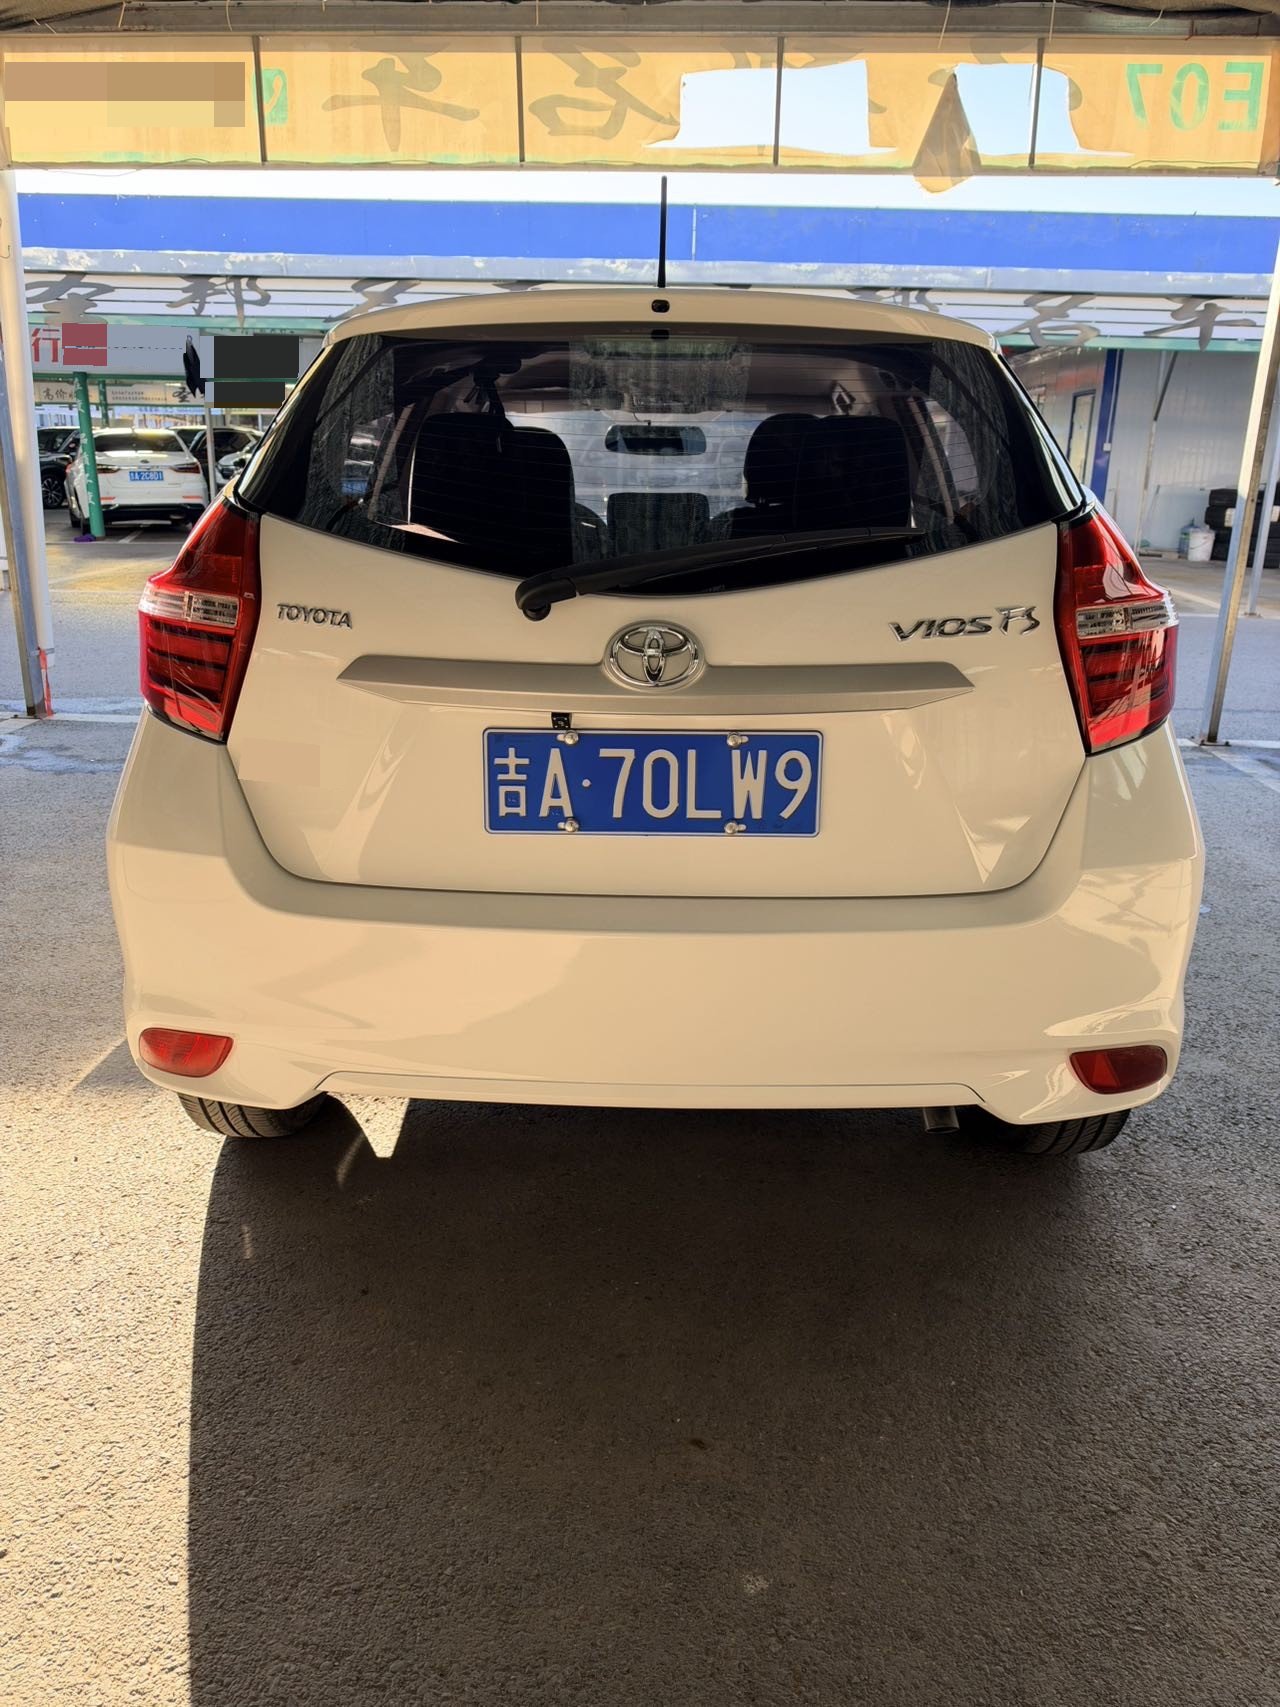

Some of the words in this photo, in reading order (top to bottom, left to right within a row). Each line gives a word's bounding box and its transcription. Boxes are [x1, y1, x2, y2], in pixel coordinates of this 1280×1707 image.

[277, 603, 353, 629] TOYOTA
[889, 616, 993, 641] VIOS
[493, 747, 813, 820] 吉A·70LW9
